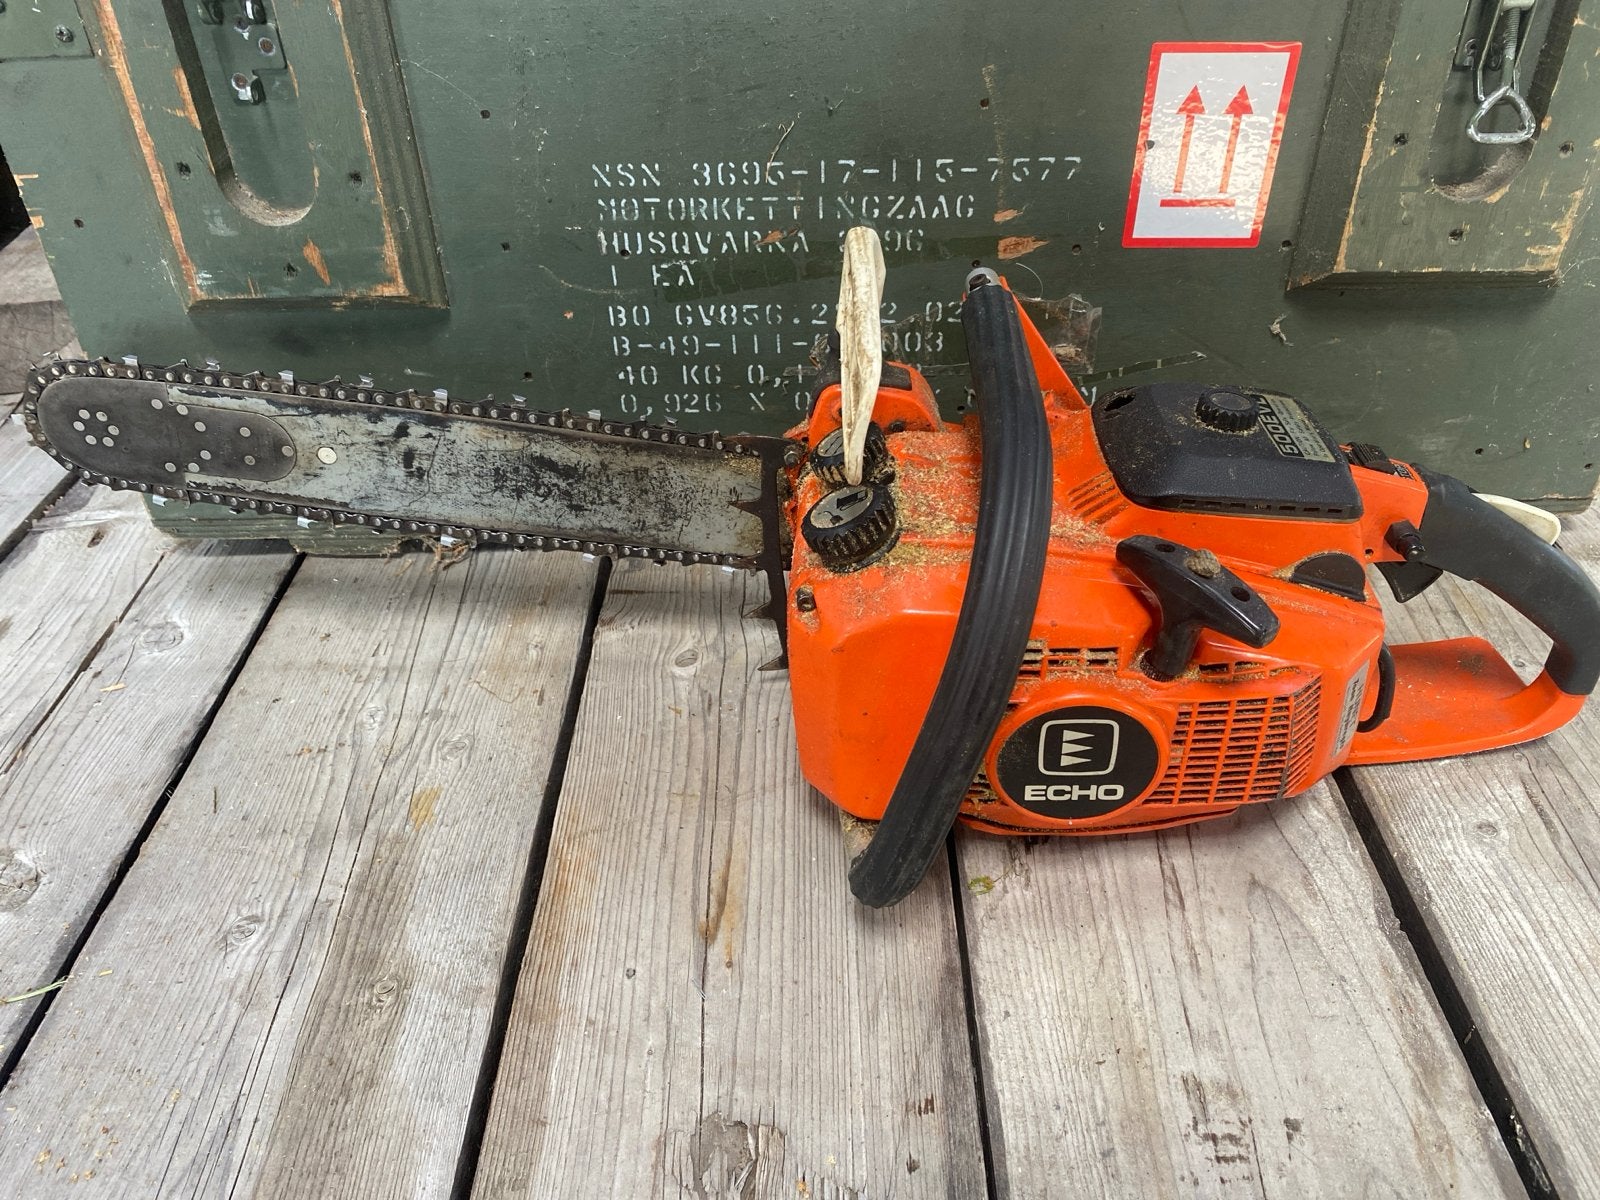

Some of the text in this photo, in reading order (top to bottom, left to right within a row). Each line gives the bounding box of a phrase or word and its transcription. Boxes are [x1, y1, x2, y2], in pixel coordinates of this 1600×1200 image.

[592, 162, 661, 188] NSN
[597, 194, 975, 221] MOTORKETTINGZAAG
[651, 263, 695, 287] EA
[618, 364, 658, 386] 40
[681, 363, 723, 386] KG
[748, 391, 766, 412] X
[1023, 783, 1125, 801] ECHO
